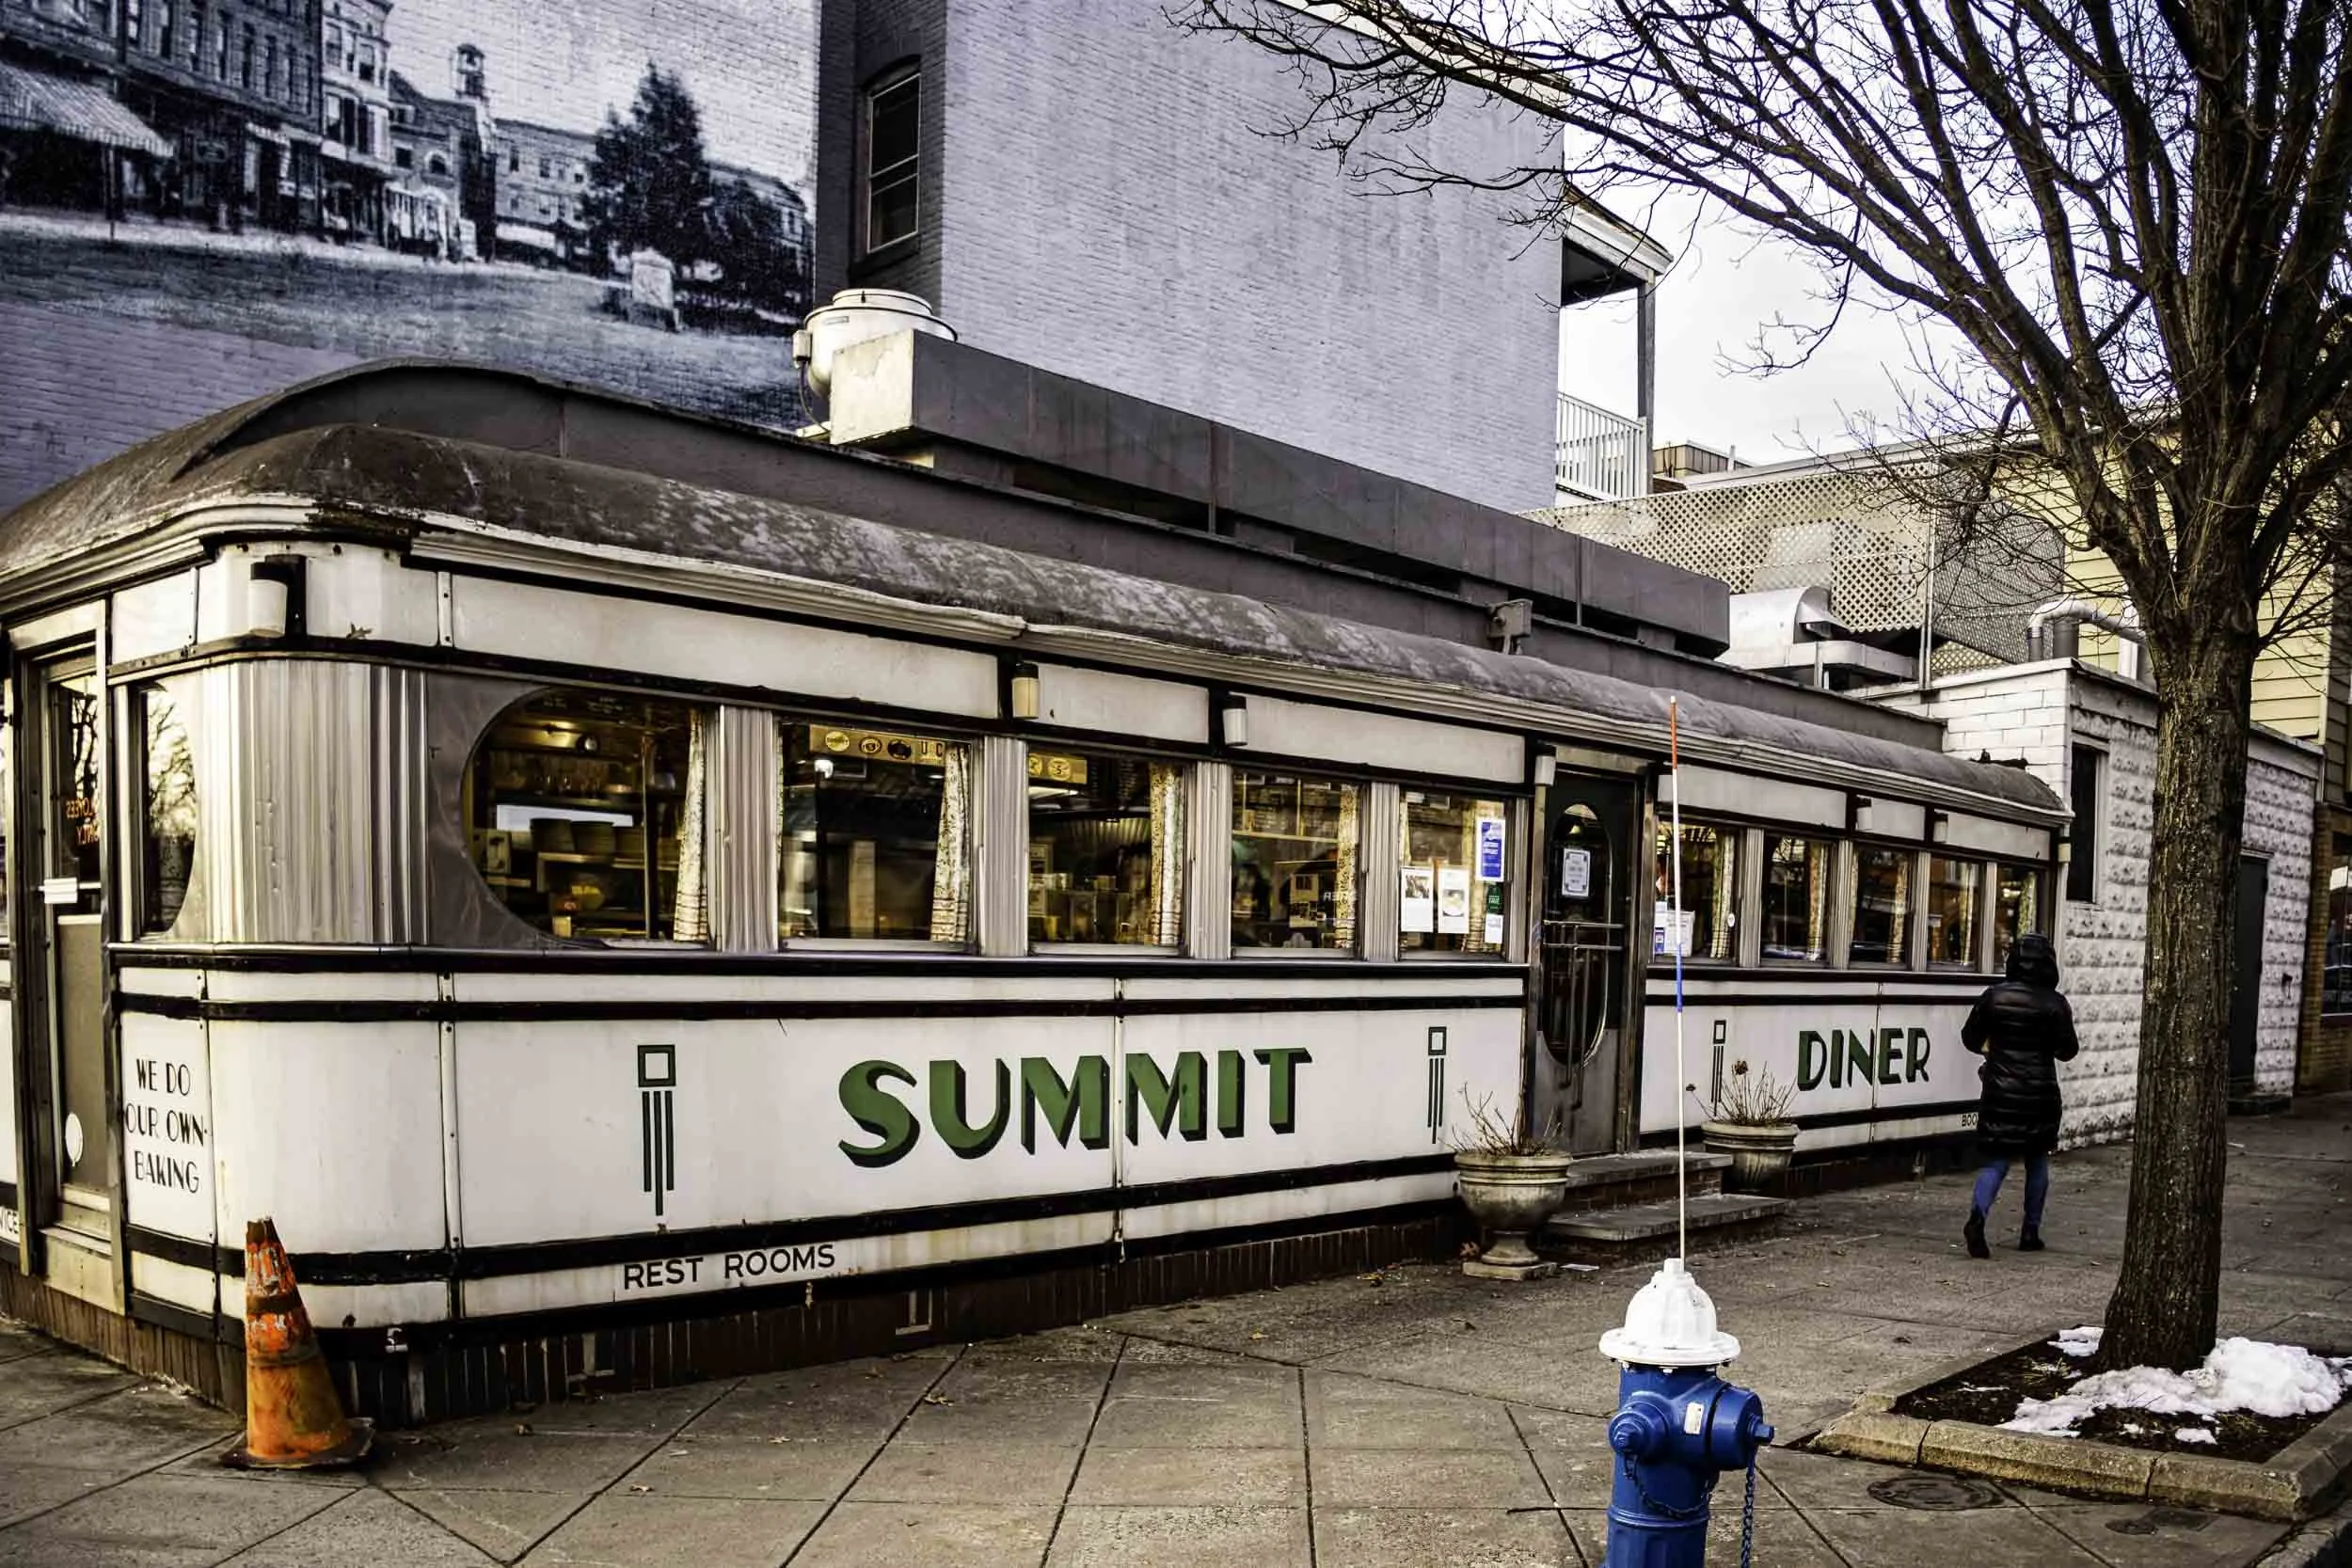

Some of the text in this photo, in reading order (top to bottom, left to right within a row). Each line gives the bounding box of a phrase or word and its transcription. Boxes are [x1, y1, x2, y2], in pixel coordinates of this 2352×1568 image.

[135, 1058, 191, 1096] WE DO
[1797, 1027, 1931, 1092] DINER
[125, 1102, 204, 1147] OUR OWN
[838, 1047, 1313, 1168] SUMMIT
[135, 1150, 199, 1194] BAKING
[624, 1243, 835, 1290] REST ROOMS
